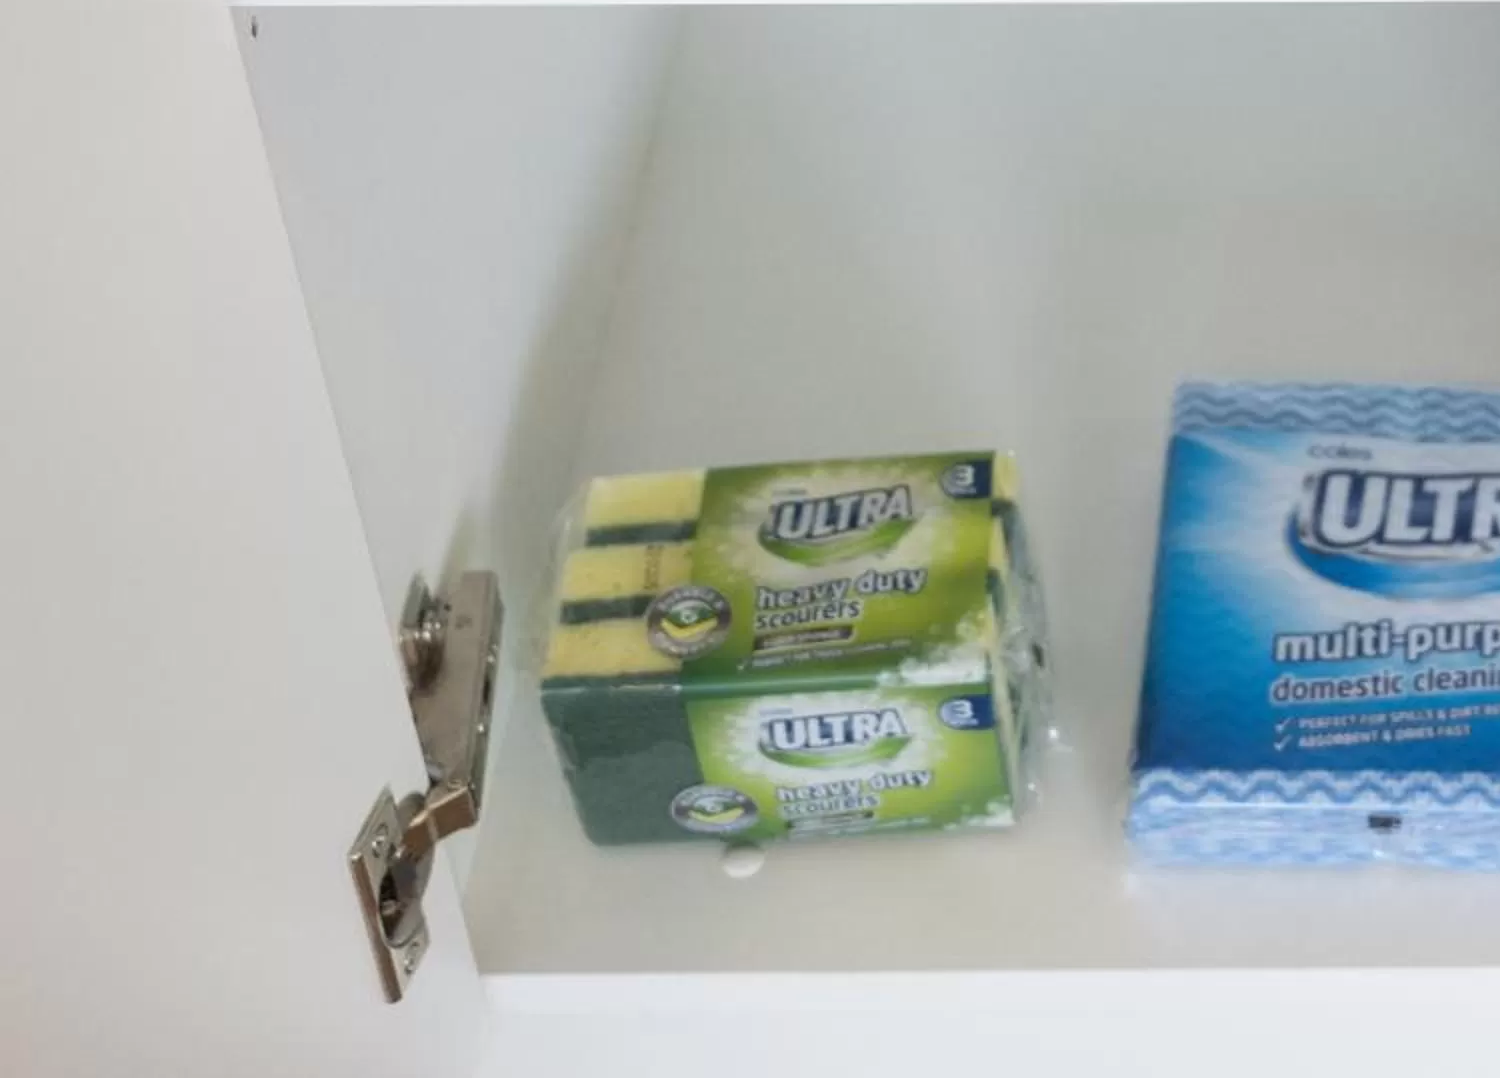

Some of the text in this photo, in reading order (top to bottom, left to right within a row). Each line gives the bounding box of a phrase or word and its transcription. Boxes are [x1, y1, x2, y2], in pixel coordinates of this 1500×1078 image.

[954, 464, 975, 487] 3
[774, 484, 913, 540] ULTRA
[756, 567, 928, 610] heavy duty
[755, 599, 861, 630] scourers
[1273, 670, 1403, 703] domestic
[769, 707, 908, 751] ULTRA
[777, 770, 933, 803] heavy duty
[781, 794, 879, 815] scourers
